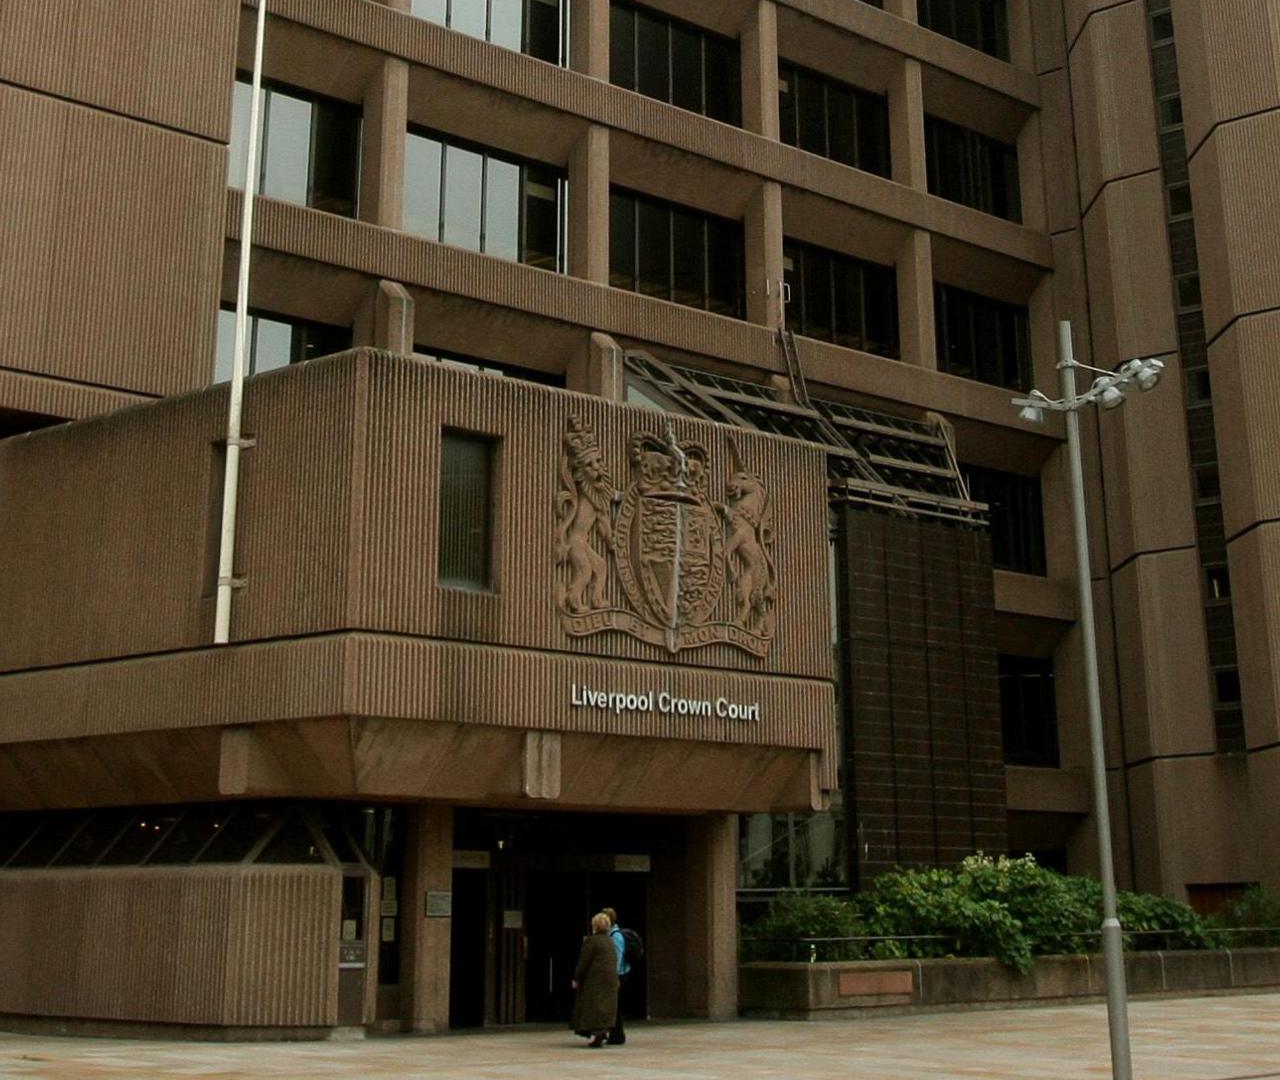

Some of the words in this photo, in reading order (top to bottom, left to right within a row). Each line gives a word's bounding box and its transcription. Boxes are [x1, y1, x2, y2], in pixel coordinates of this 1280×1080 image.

[572, 612, 611, 633] DIEU
[680, 625, 719, 645] MON
[571, 684, 653, 713] Liverpool
[658, 692, 711, 717] Crown
[716, 697, 760, 721] Court
